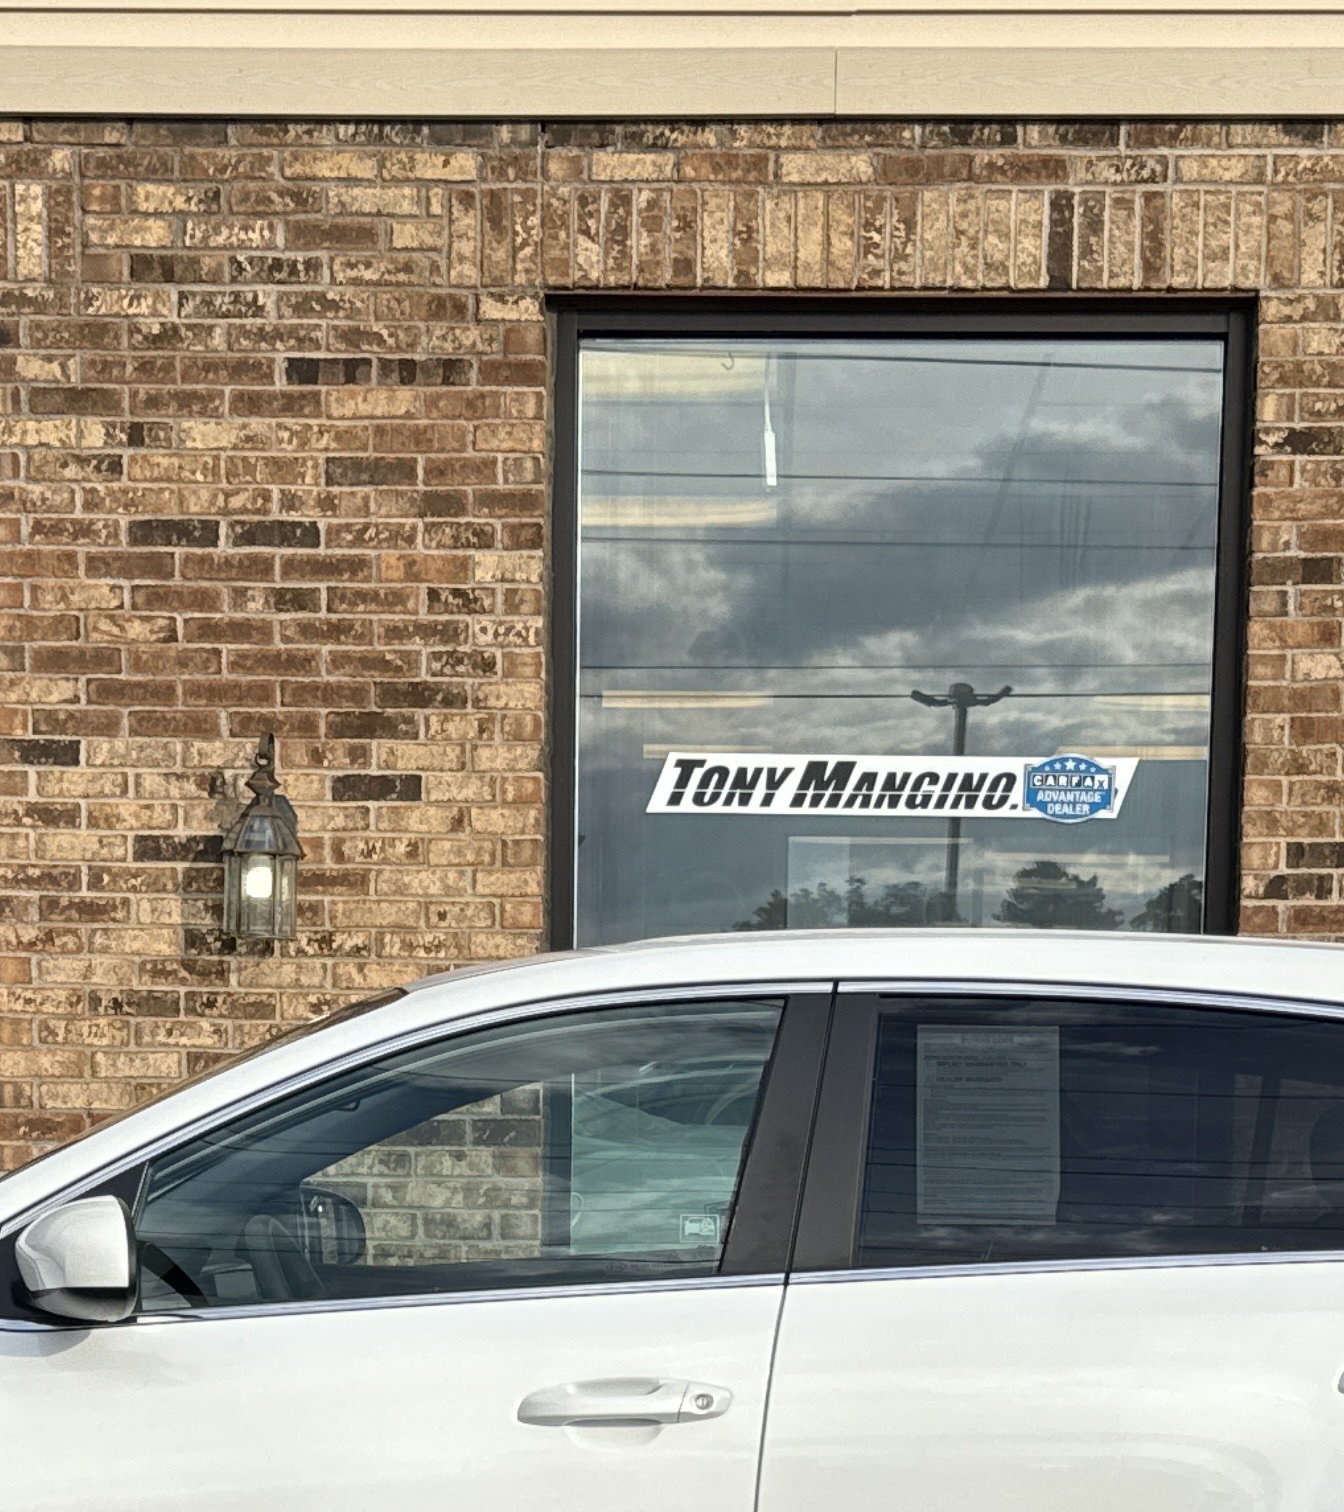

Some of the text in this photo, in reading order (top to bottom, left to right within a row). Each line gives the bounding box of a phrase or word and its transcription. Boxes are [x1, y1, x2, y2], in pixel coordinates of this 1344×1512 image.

[666, 759, 794, 808] TONY
[1032, 774, 1108, 789] CARFAX
[1036, 790, 1103, 803] ADVANTAGE
[1047, 803, 1090, 815] DEALER
